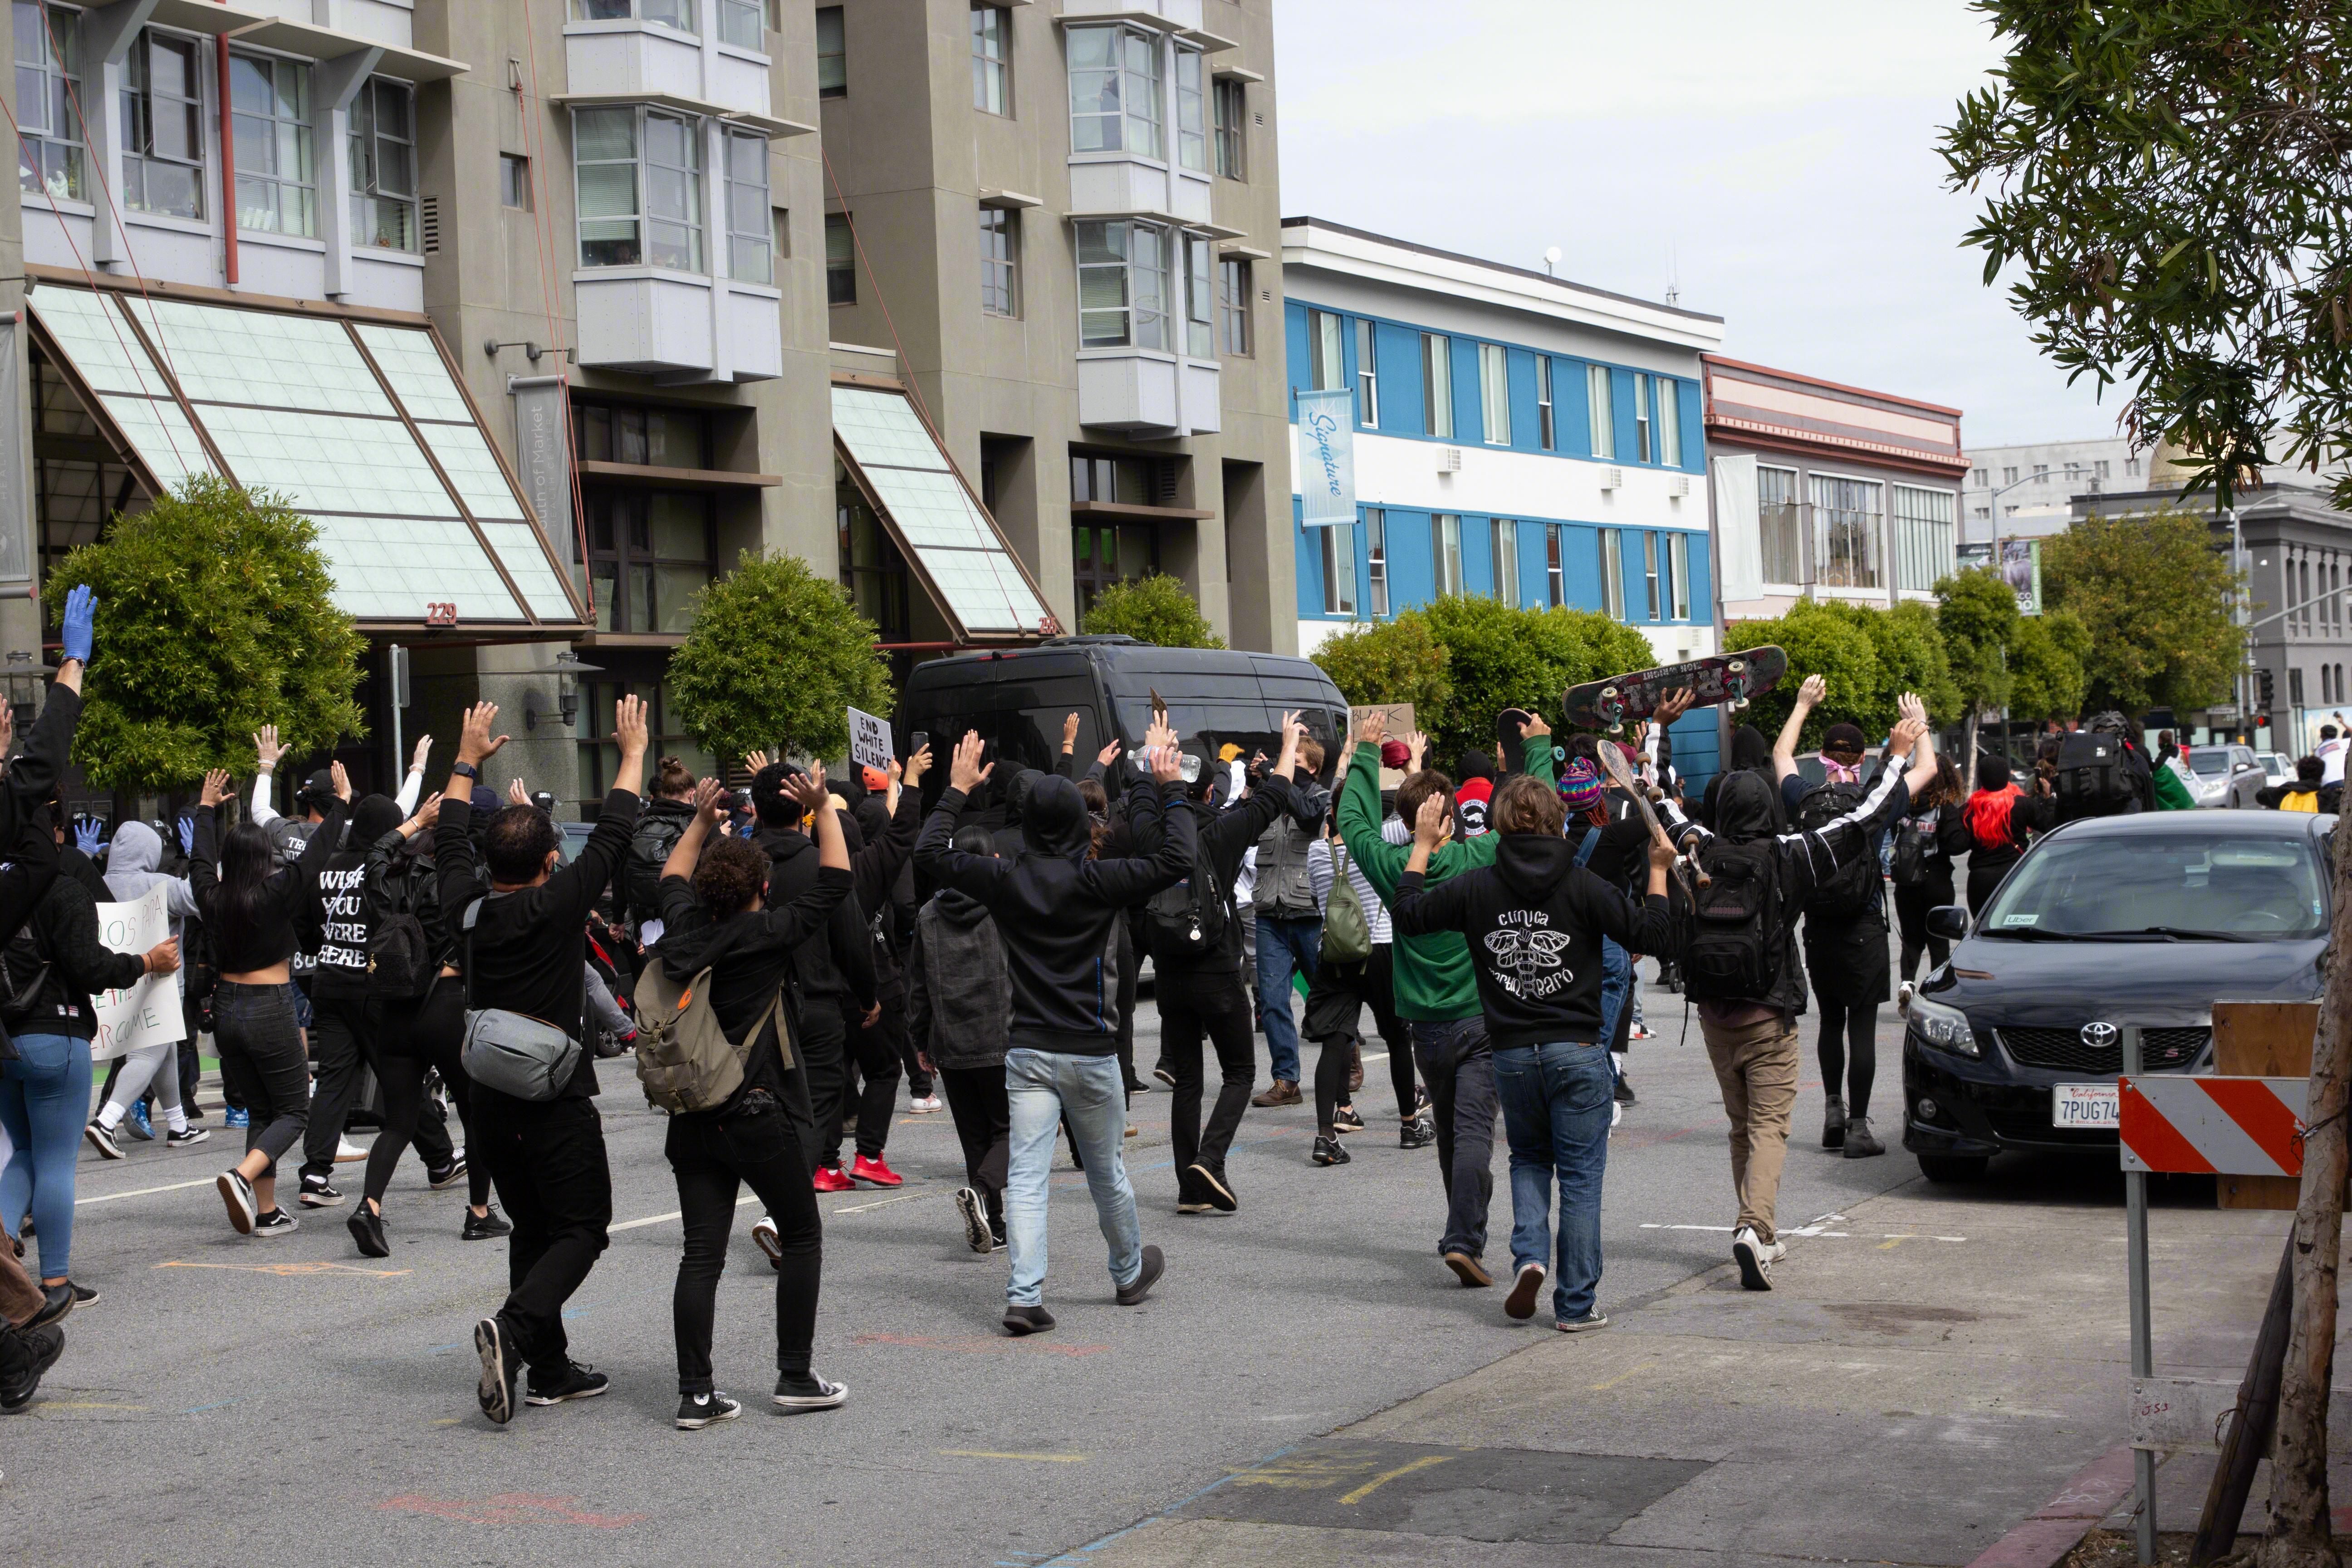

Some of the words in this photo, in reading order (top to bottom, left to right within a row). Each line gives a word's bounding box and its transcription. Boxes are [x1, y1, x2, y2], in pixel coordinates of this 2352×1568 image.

[531, 406, 544, 463] Market
[547, 418, 555, 469] CENTER
[1305, 412, 1341, 497] Signature
[533, 469, 544, 486] of
[427, 603, 456, 624] 229
[1039, 617, 1057, 633] 255
[1623, 667, 1725, 712] RL
[860, 716, 878, 735] END
[858, 730, 884, 752] WHITE
[321, 896, 361, 916] YOU
[320, 922, 367, 942] WERE
[318, 945, 367, 967] HERE
[2073, 1088, 2119, 1100] California
[2061, 1101, 2119, 1120] 7PUG74
